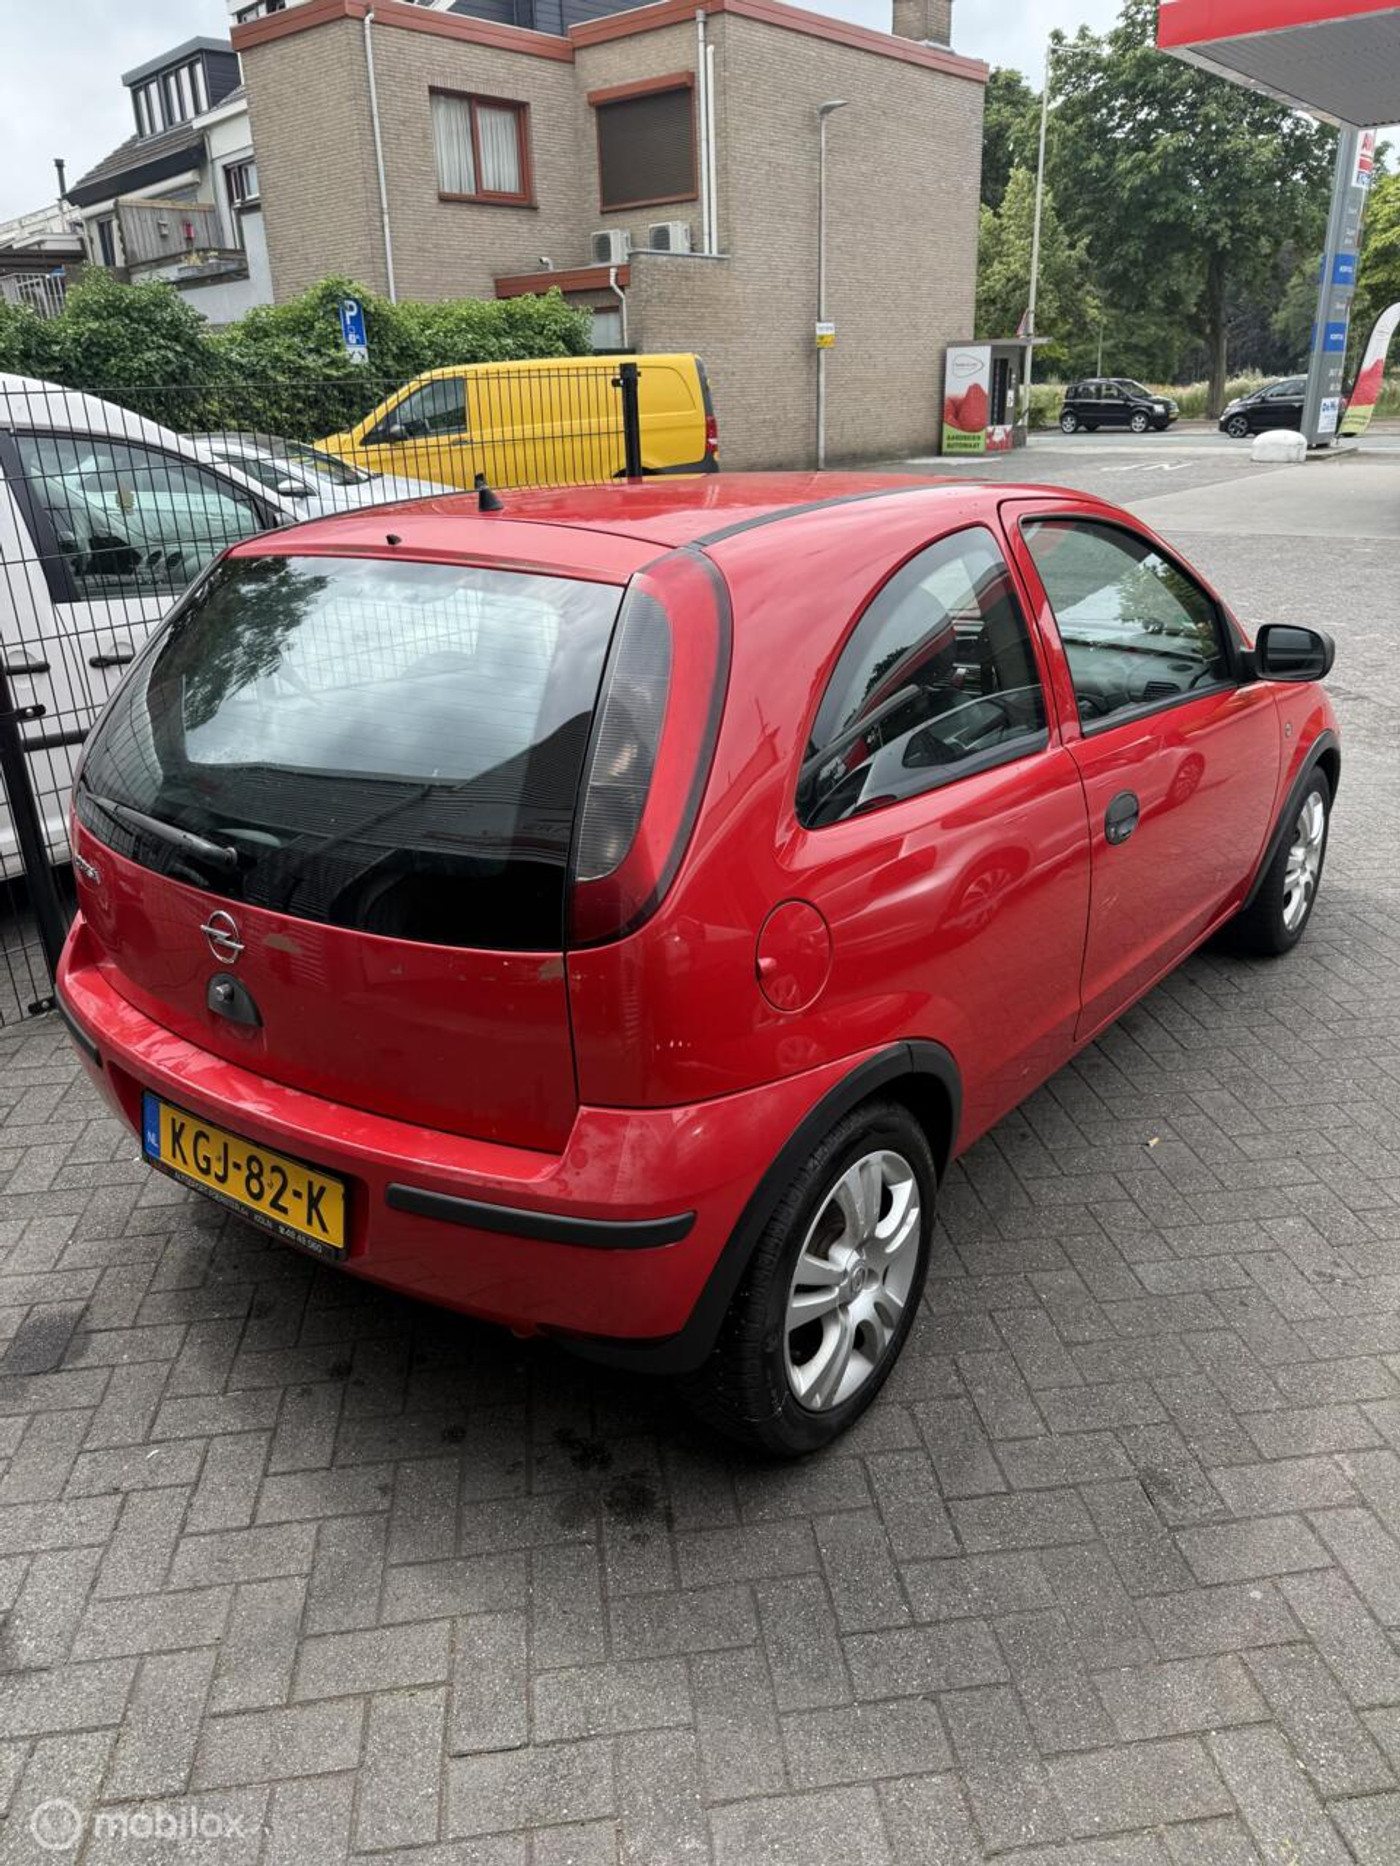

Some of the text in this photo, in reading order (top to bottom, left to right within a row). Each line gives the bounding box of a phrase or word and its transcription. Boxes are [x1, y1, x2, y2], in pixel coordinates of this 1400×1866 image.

[344, 300, 358, 325] P
[147, 1131, 159, 1148] NL
[170, 1117, 330, 1234] KGJ-82-K
